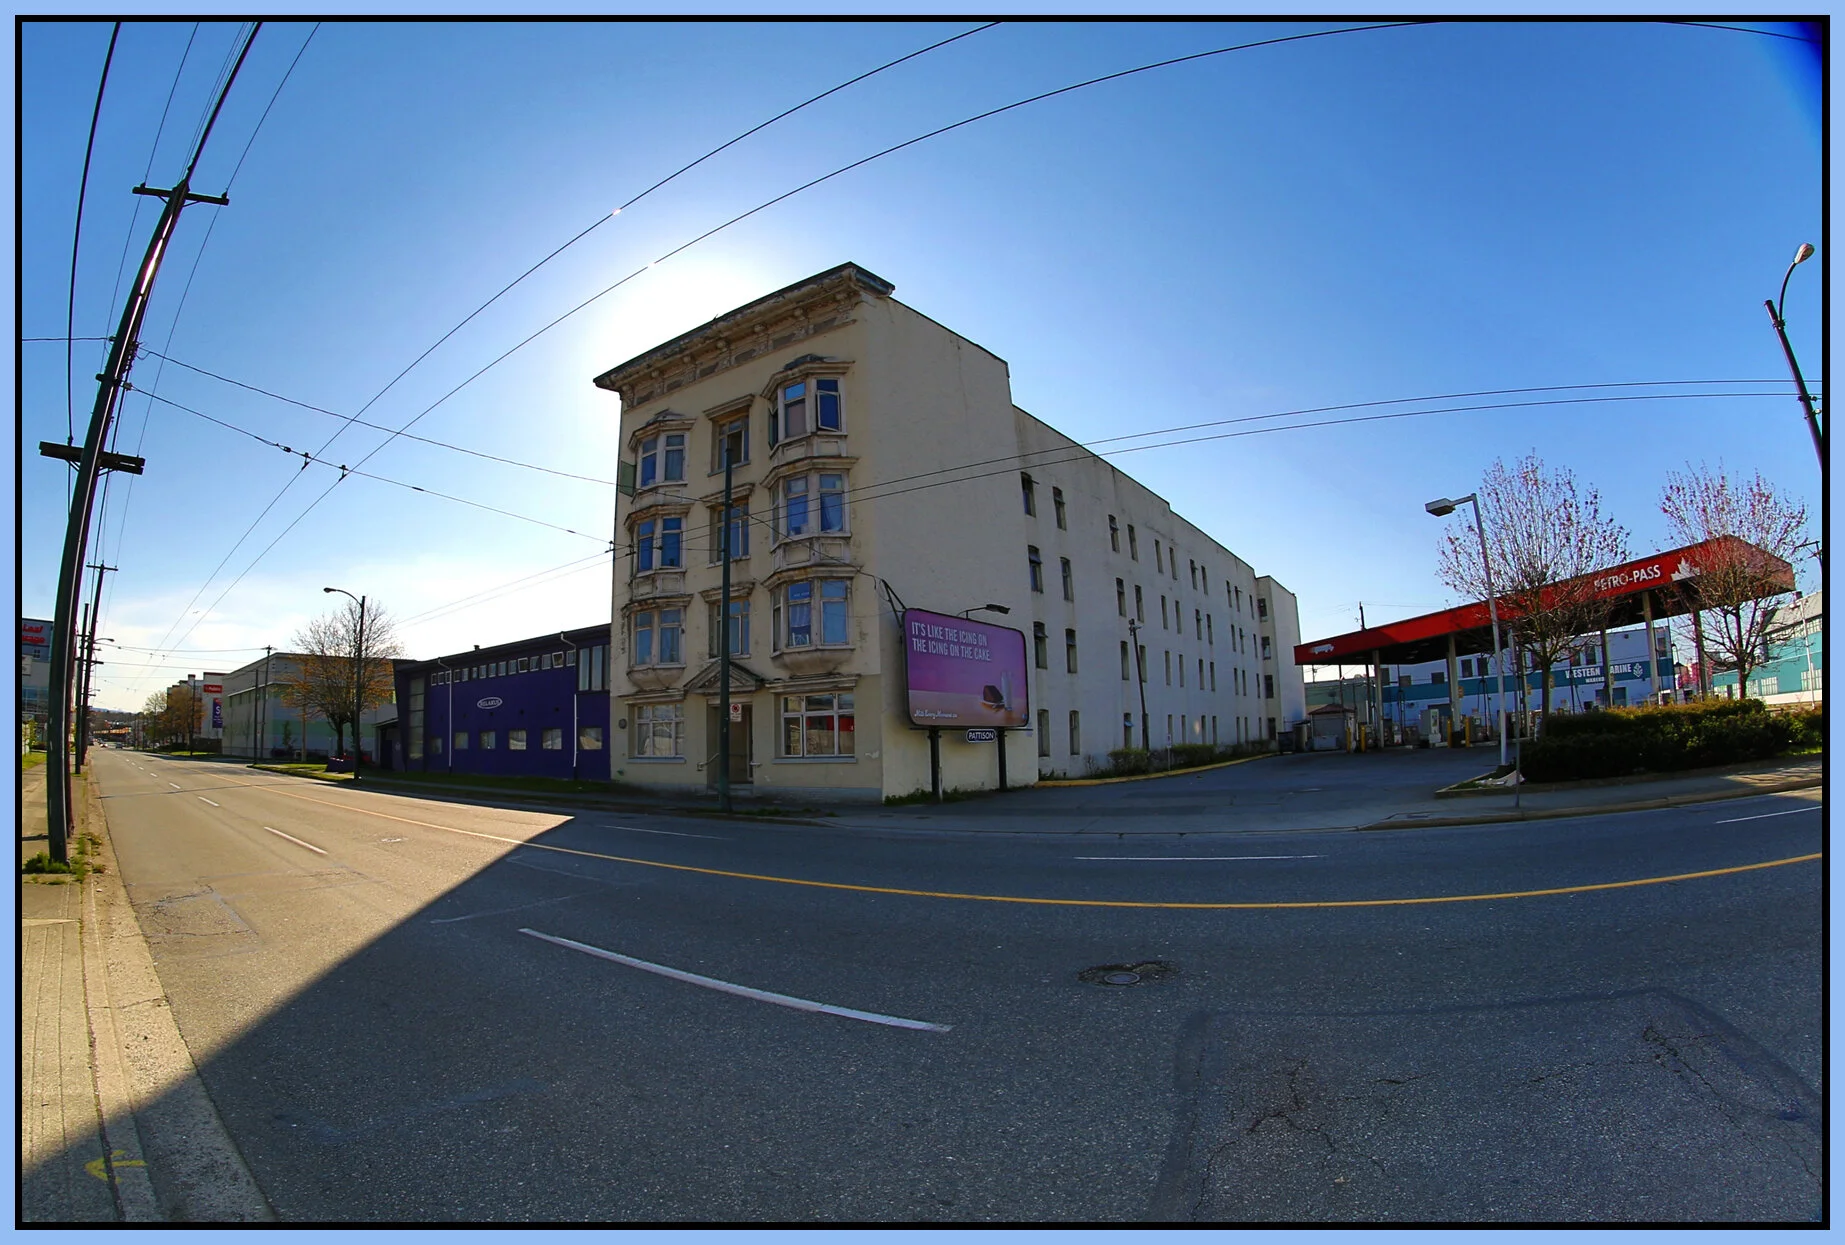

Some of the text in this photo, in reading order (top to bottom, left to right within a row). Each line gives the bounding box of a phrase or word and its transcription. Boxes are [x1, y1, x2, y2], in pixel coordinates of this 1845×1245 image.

[1594, 565, 1661, 591] PETRO-PASS
[911, 622, 988, 647] IT'S LIKE THE ICING ON
[912, 638, 927, 653] THE
[928, 641, 948, 656] ICING
[949, 644, 960, 657] ON
[960, 646, 973, 659] THE
[1609, 663, 1632, 674] ARINE
[968, 731, 994, 740] PATTISON
